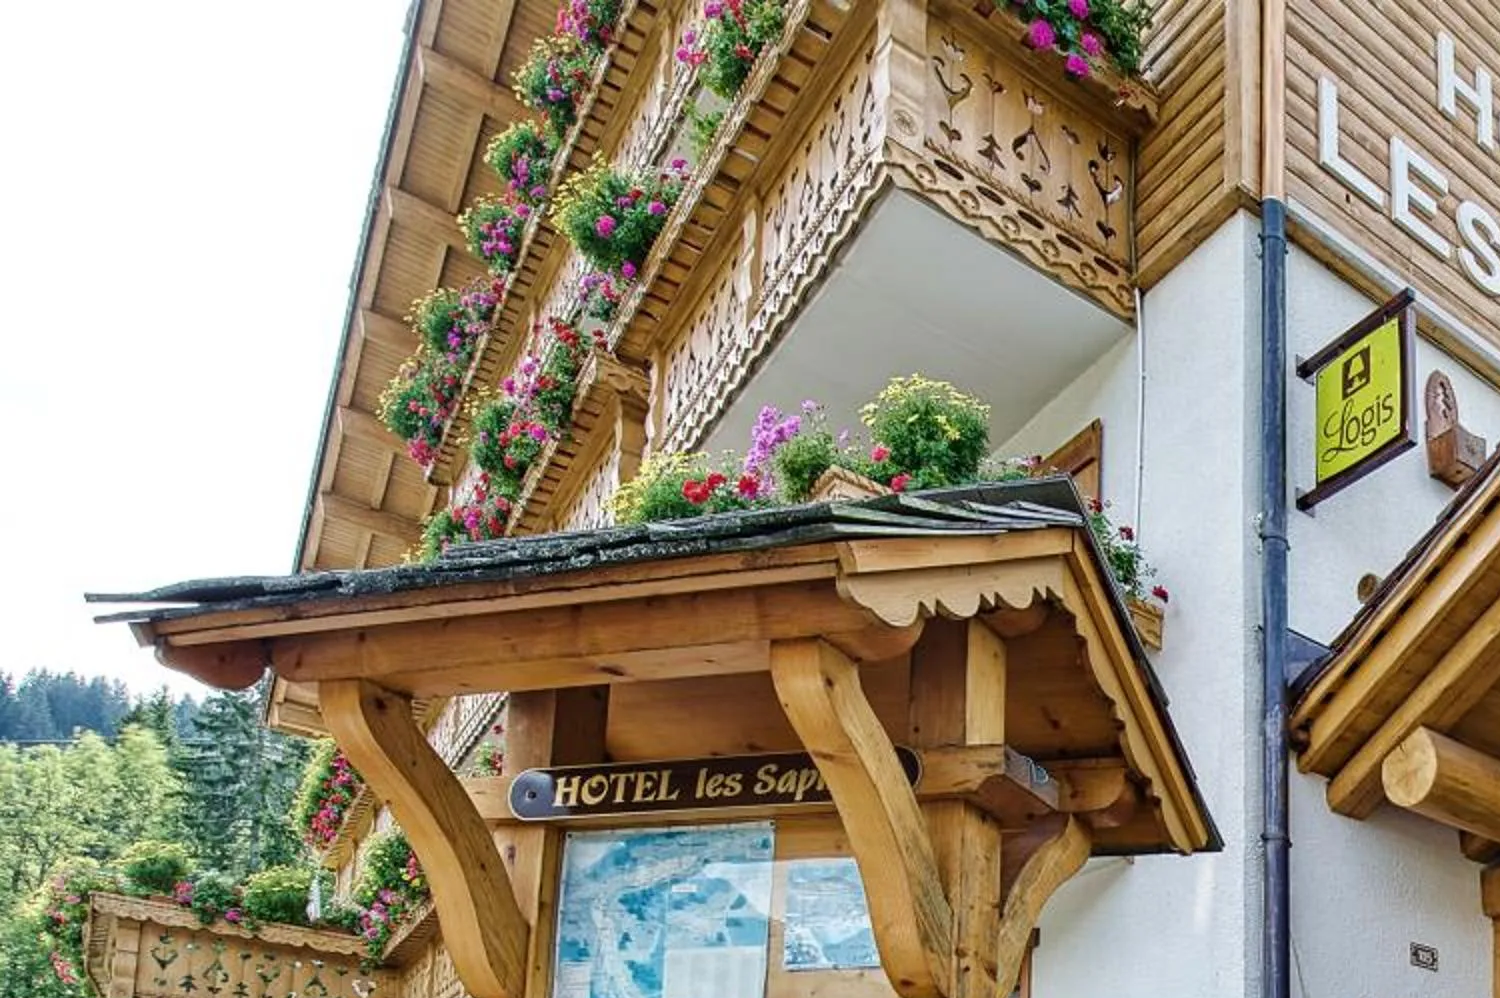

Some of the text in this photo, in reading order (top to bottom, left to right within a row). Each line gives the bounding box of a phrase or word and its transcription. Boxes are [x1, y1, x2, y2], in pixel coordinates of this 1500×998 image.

[1321, 392, 1395, 463] Logis
[551, 763, 825, 808] HOTEL les Sapi
